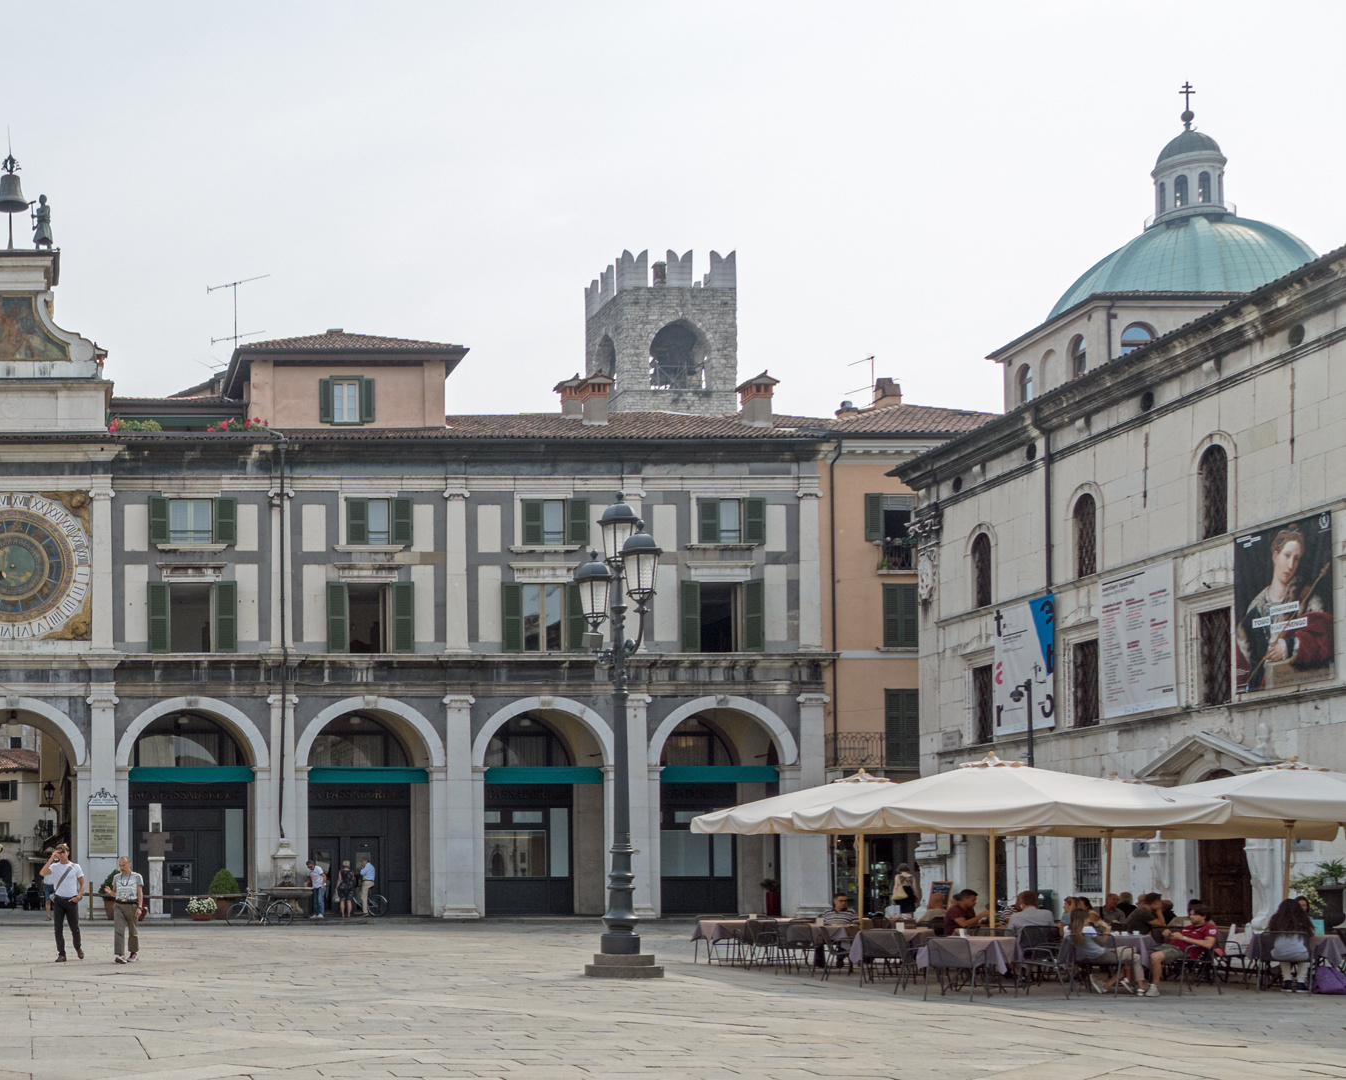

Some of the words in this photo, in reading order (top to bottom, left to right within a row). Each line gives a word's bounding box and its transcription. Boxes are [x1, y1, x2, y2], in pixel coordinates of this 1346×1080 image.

[31, 499, 48, 513] XX
[47, 503, 64, 522] XXI
[60, 517, 77, 535] XXII
[72, 586, 85, 597] II
[62, 599, 77, 614] III
[49, 611, 64, 626] IIII
[17, 626, 30, 637] VI
[38, 622, 47, 634] V
